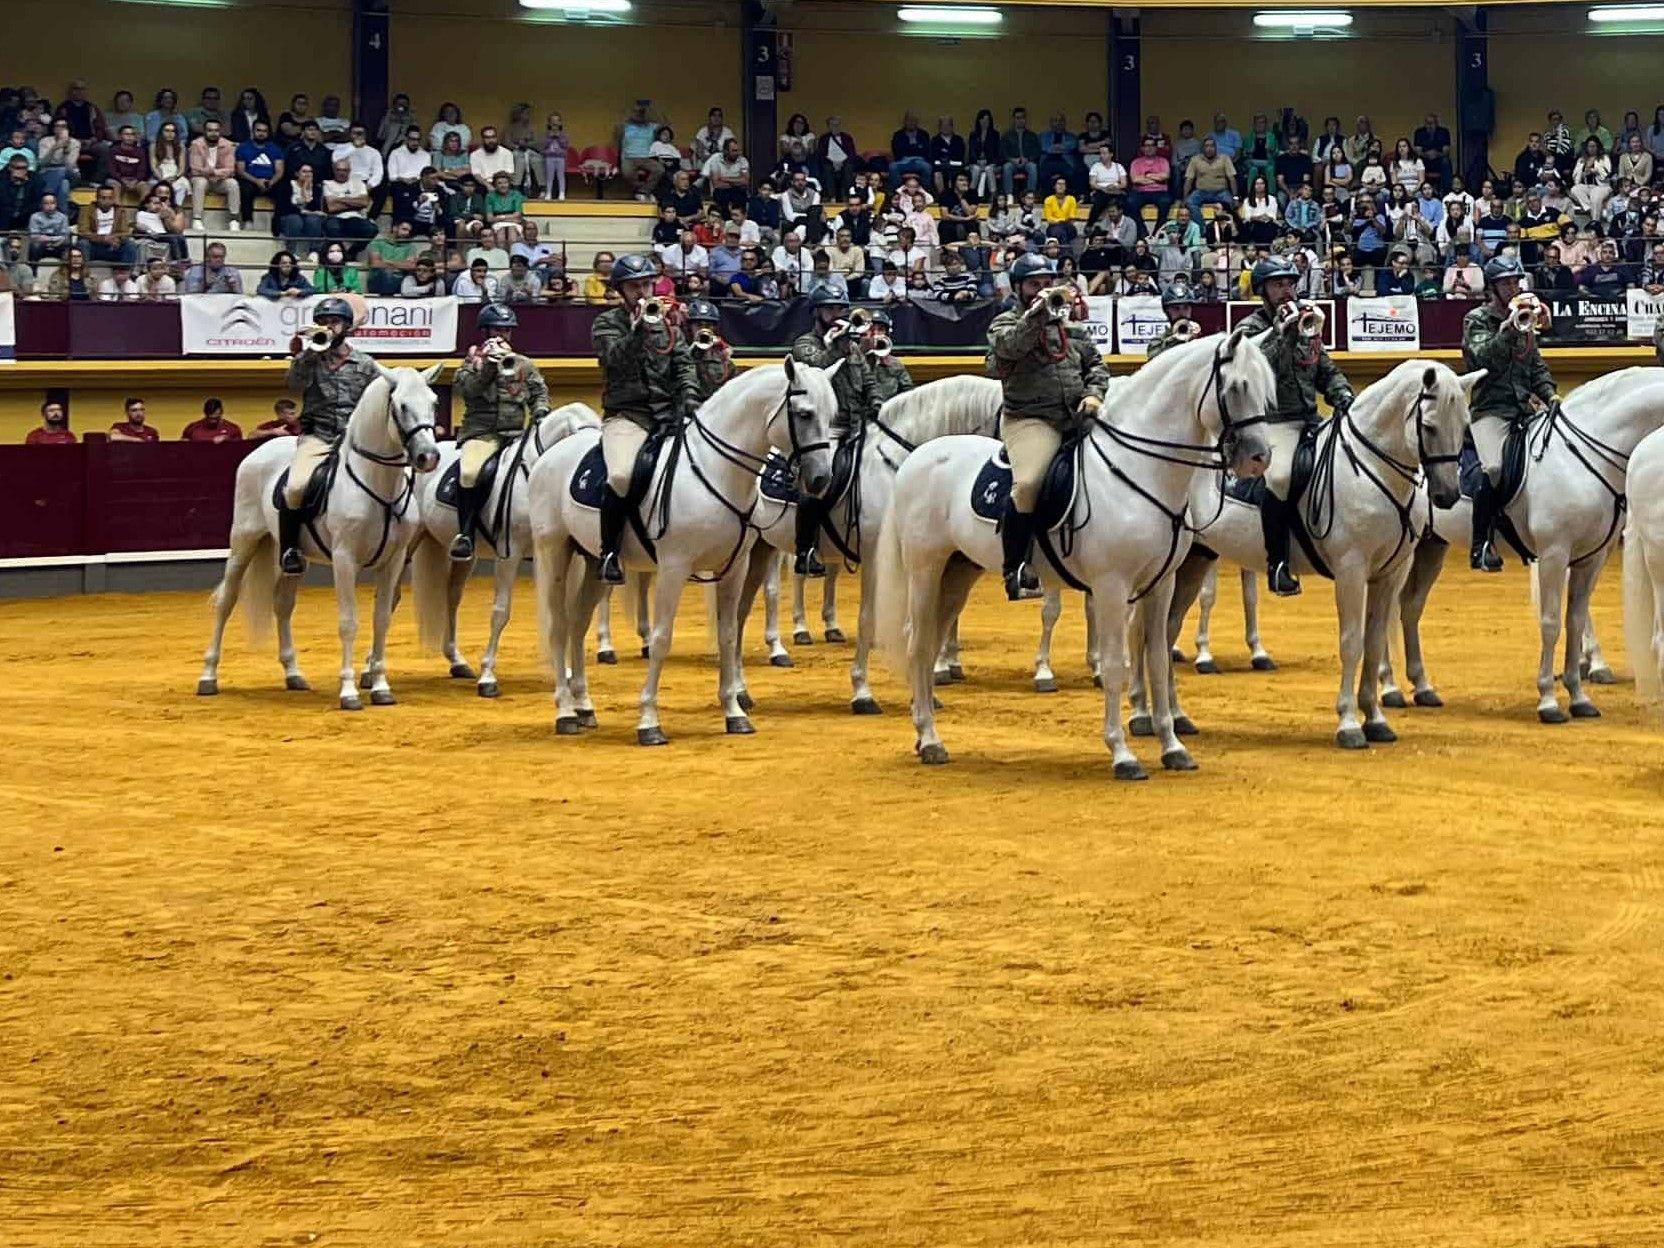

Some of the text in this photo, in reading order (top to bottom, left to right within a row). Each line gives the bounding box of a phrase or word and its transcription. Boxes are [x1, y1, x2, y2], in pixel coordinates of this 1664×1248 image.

[369, 33, 381, 49] 4
[758, 46, 769, 62] 3
[1472, 52, 1482, 68] 3
[1124, 55, 1135, 70] 3
[1552, 300, 1627, 317] LA ENCINA
[1358, 312, 1416, 334] TEJEMO
